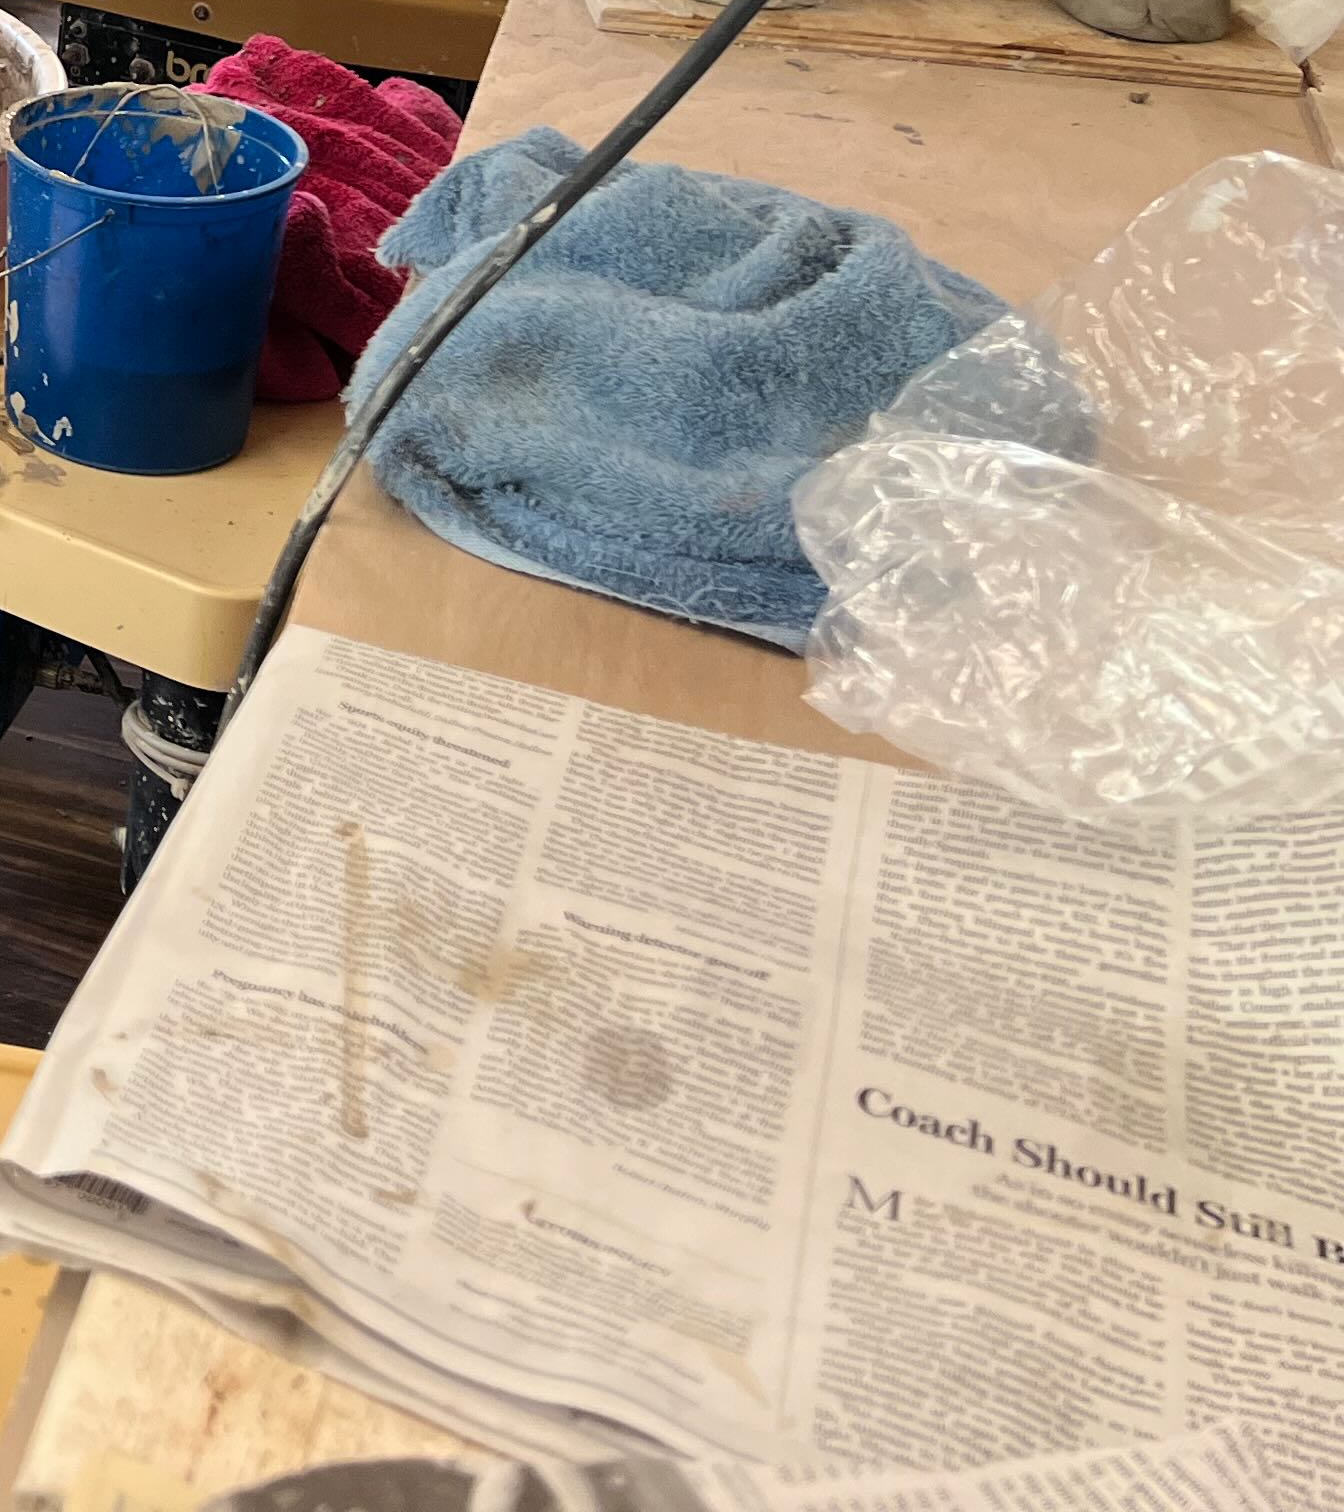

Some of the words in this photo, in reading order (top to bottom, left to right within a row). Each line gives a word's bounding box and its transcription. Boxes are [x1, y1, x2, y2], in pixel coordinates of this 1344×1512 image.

[856, 1086, 996, 1156] Coach
[1010, 1136, 1180, 1217] Should
[1194, 1199, 1295, 1249] Still
